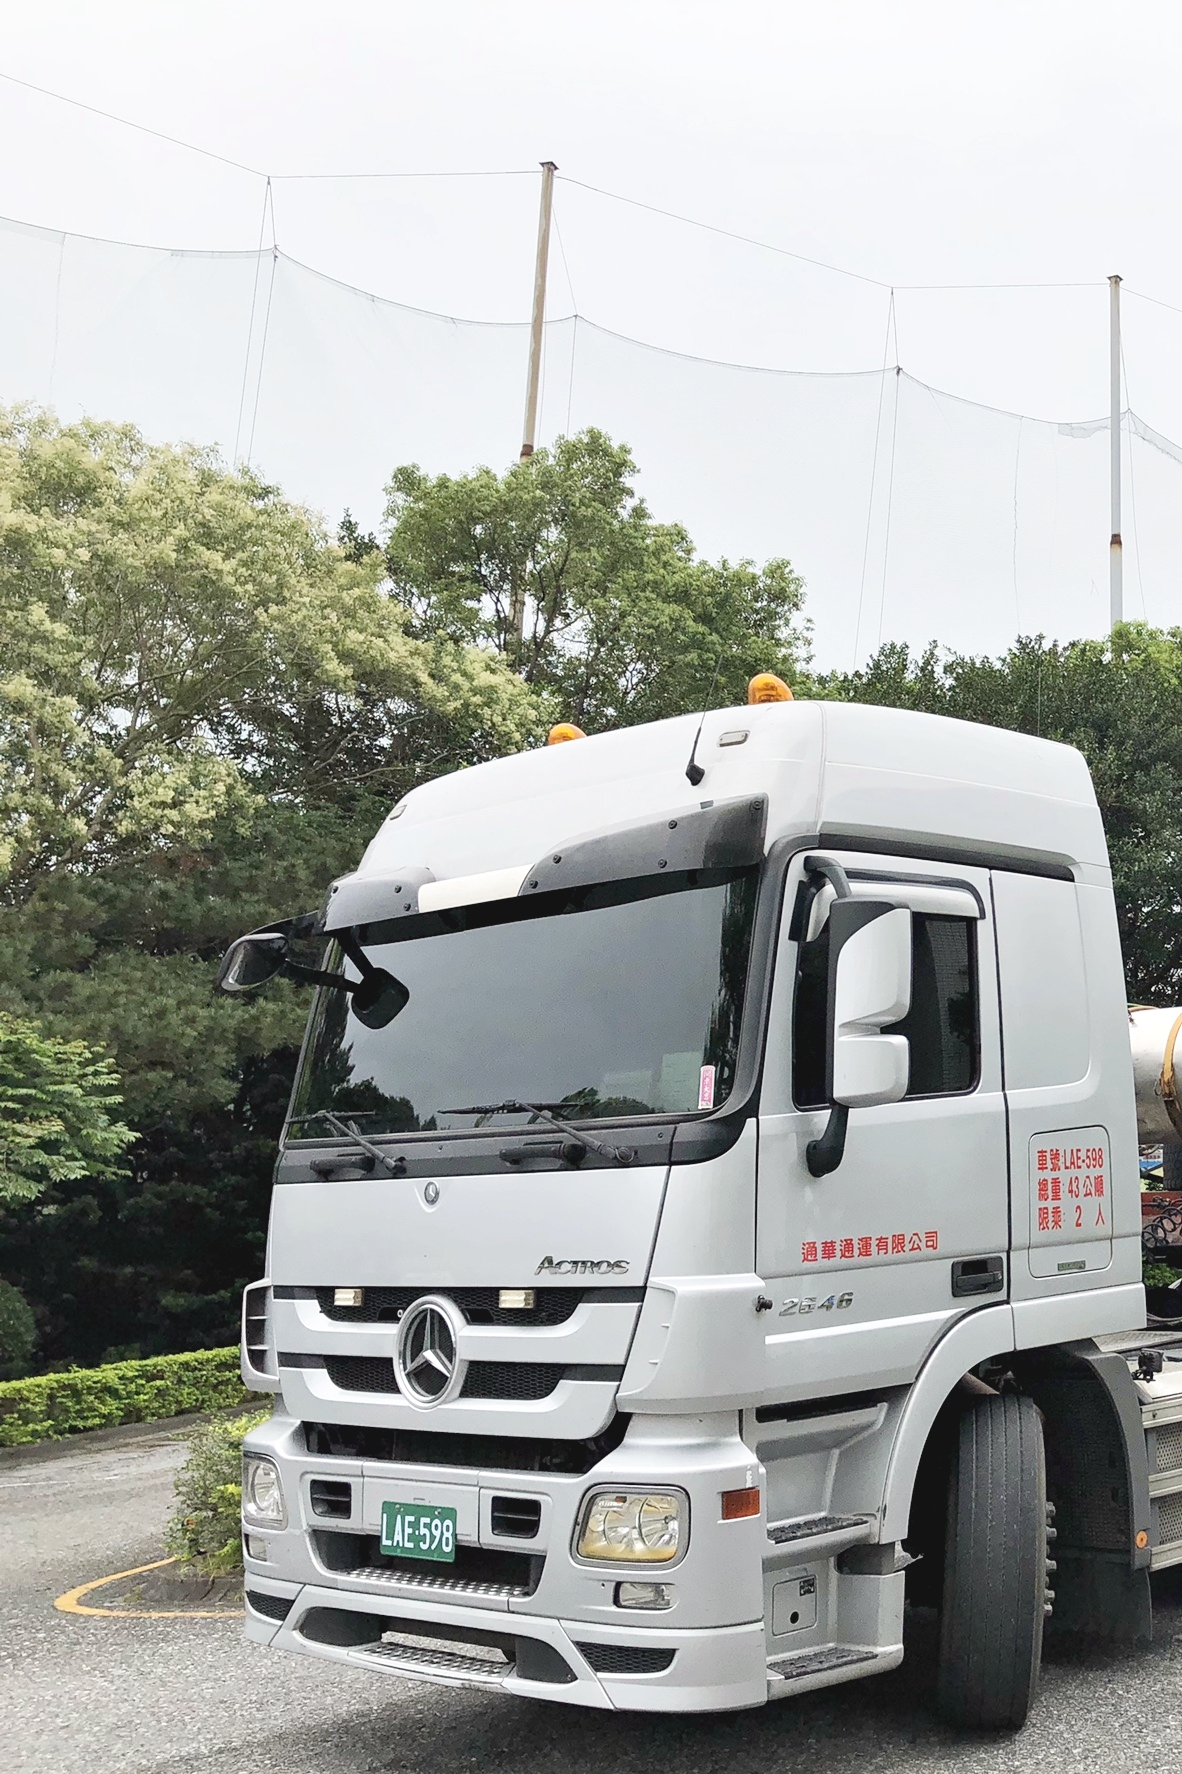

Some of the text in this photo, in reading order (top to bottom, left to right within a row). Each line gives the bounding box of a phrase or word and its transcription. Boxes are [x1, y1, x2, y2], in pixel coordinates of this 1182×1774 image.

[1068, 1176, 1080, 1198] 43
[1075, 1205, 1082, 1227] 2
[1095, 1202, 1105, 1226] 人
[801, 1231, 939, 1263] 通華通運有限公司
